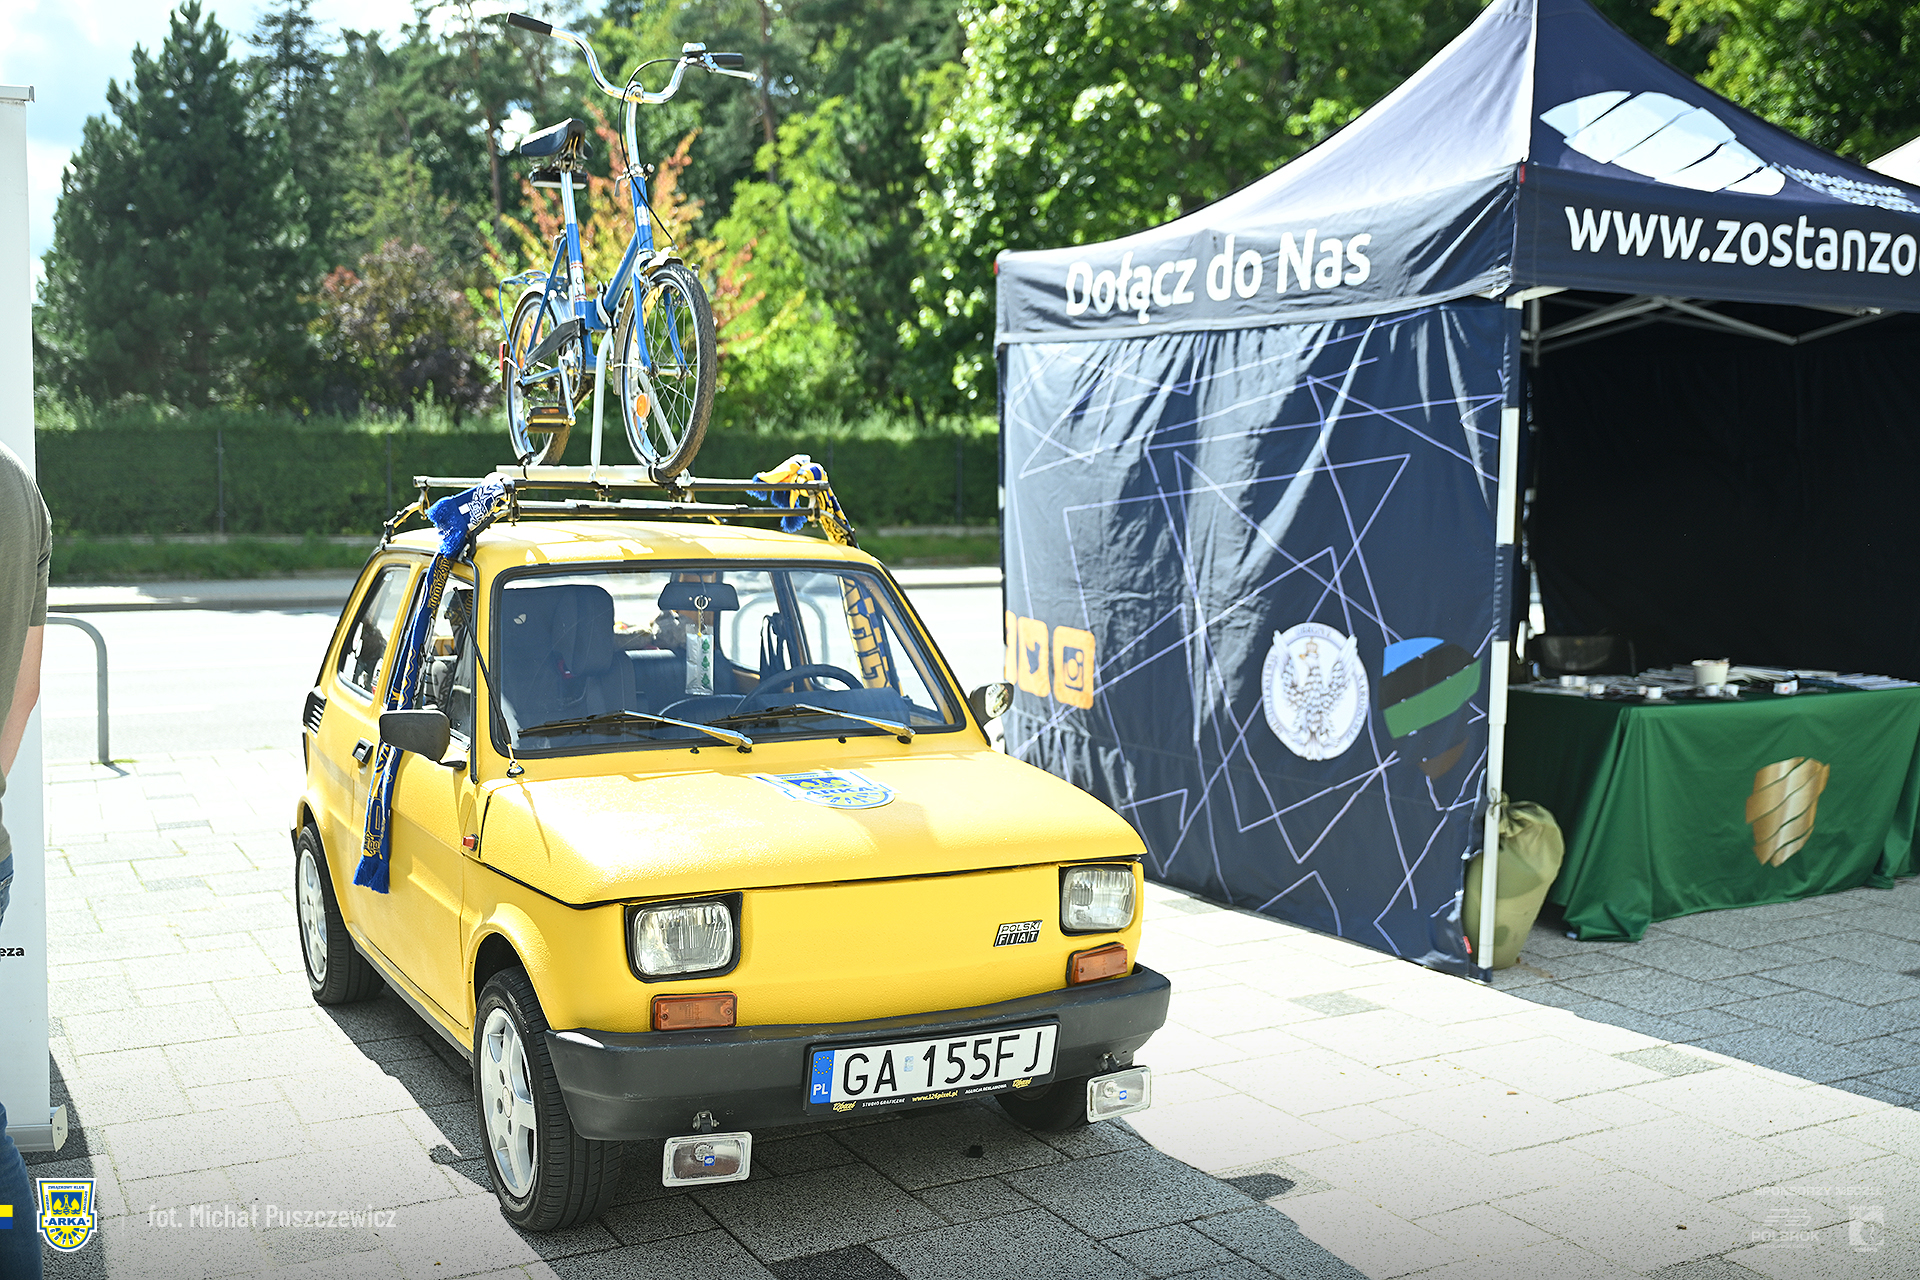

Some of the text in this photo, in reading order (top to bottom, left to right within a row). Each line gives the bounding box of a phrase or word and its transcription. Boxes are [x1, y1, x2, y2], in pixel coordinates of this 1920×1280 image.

[1565, 205, 1920, 277] www.zostanzo
[1066, 228, 1372, 324] Dołącz do Nas
[998, 931, 1037, 945] FIAT
[1001, 921, 1041, 933] POLSKI
[843, 1031, 1042, 1096] GA 155FJ
[813, 1083, 829, 1096] PL
